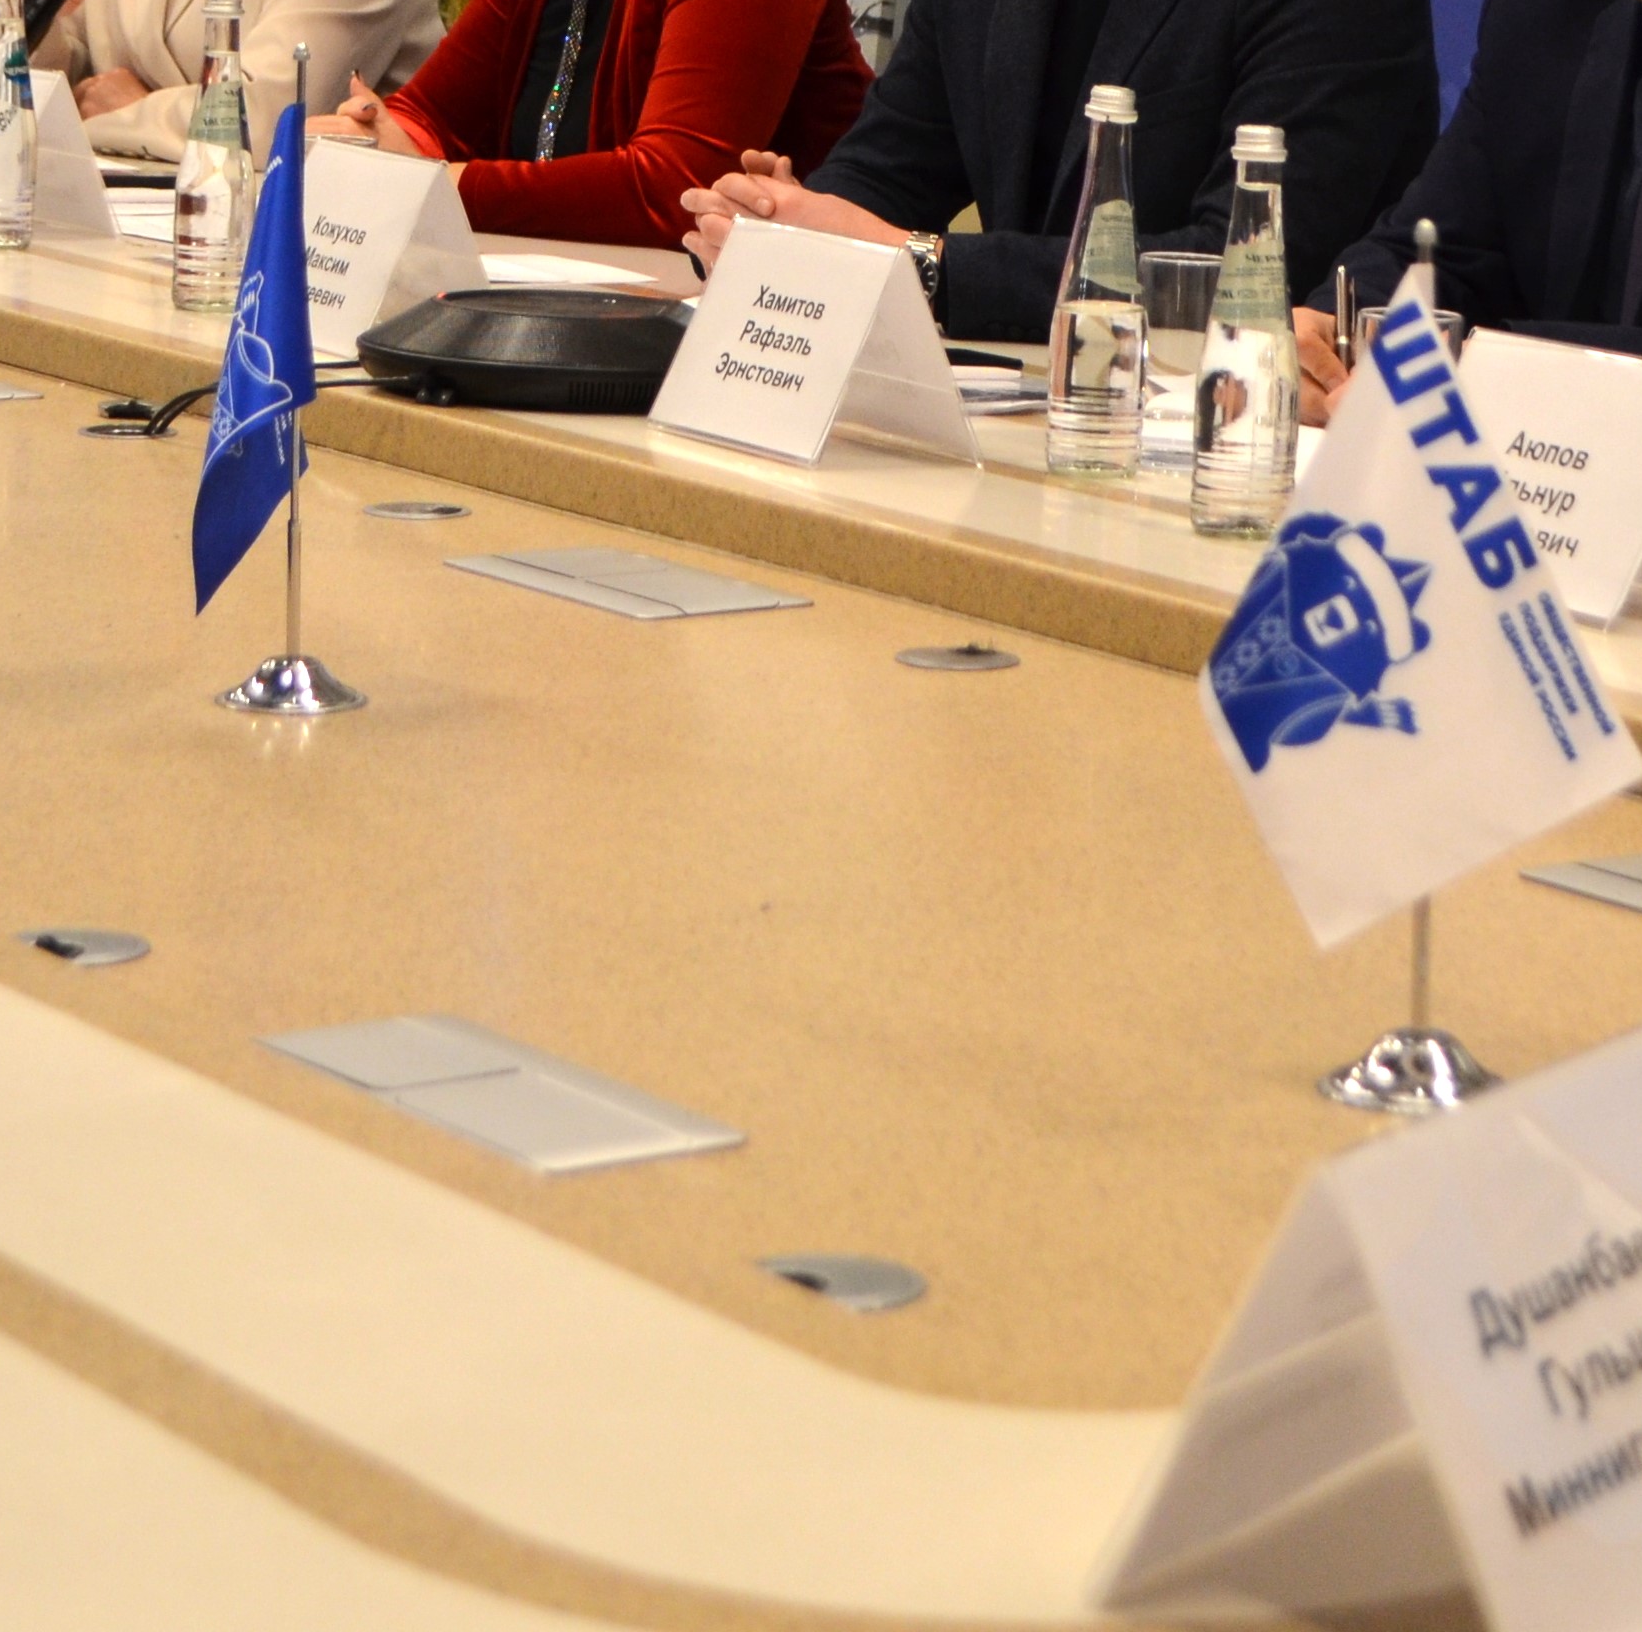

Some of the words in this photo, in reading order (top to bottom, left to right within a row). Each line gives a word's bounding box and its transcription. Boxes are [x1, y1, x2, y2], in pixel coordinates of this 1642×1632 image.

[312, 215, 367, 246] Кожухов
[307, 285, 346, 311] еевич
[752, 283, 827, 322] Хамитов
[739, 318, 813, 357] Рафаэль
[714, 352, 805, 393] Эрнстович
[1370, 298, 1540, 592] ШТАБ
[1506, 431, 1590, 472] Аюпов
[1537, 530, 1580, 558] вич
